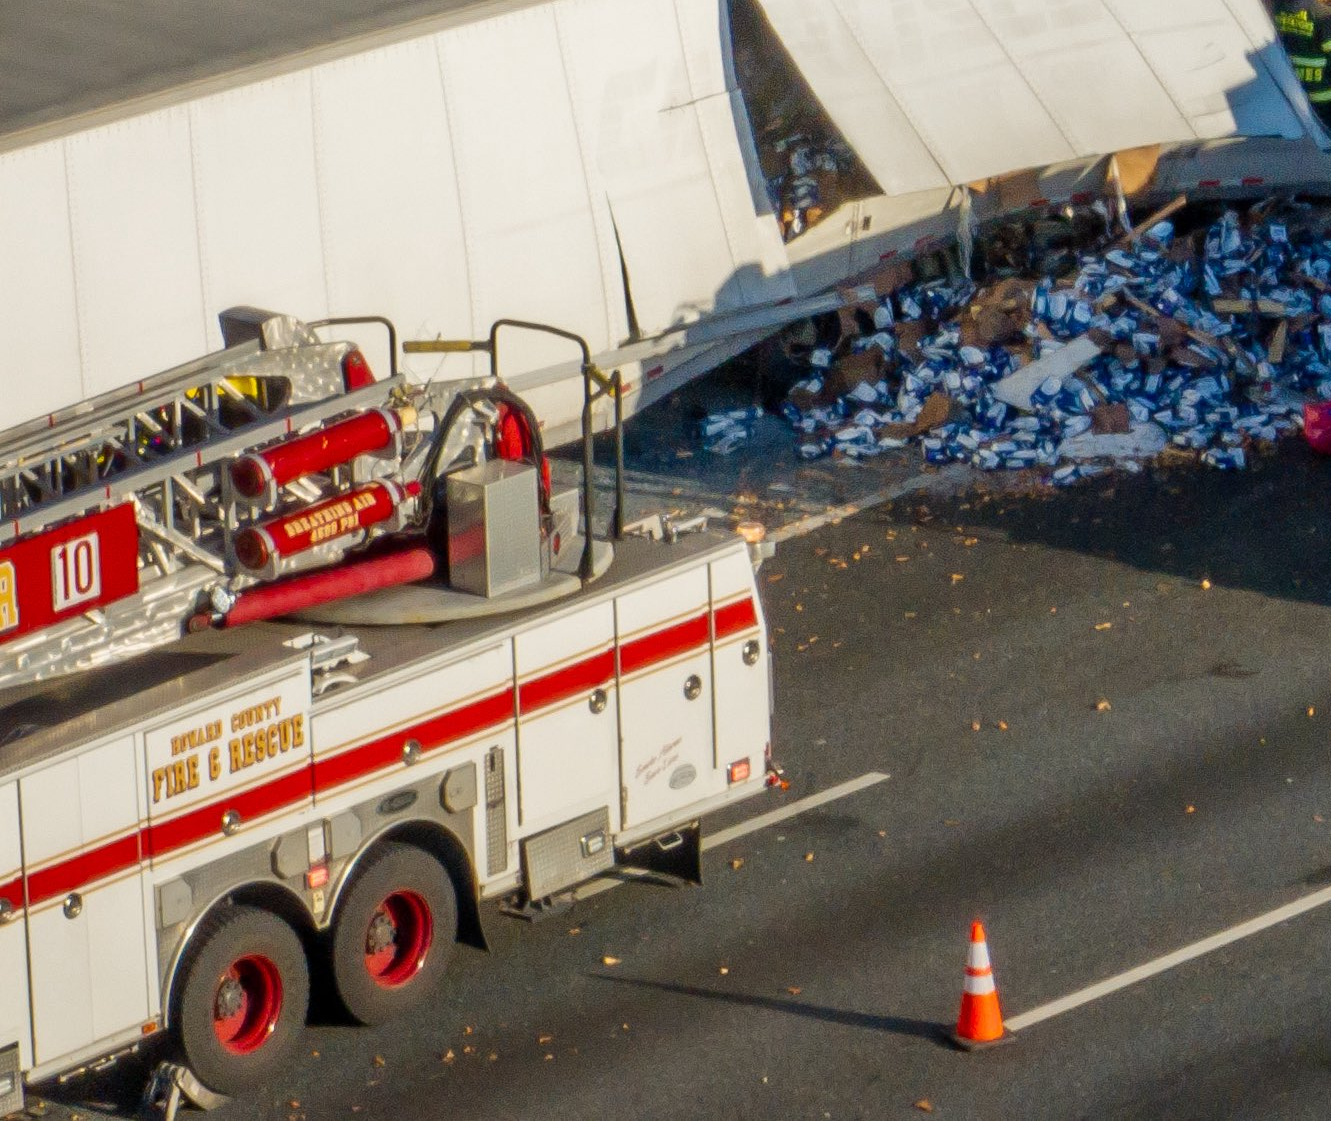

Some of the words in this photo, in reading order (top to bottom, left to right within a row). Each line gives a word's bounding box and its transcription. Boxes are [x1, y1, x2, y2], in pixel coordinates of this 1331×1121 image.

[283, 501, 353, 539] BREATHING
[352, 491, 377, 512] AIR
[339, 510, 359, 533] PSI
[57, 539, 94, 601] 10
[170, 718, 223, 757] HOWARD
[230, 695, 282, 734] COUNTY
[152, 754, 200, 805] FIRE
[228, 712, 305, 775] RESCUE
